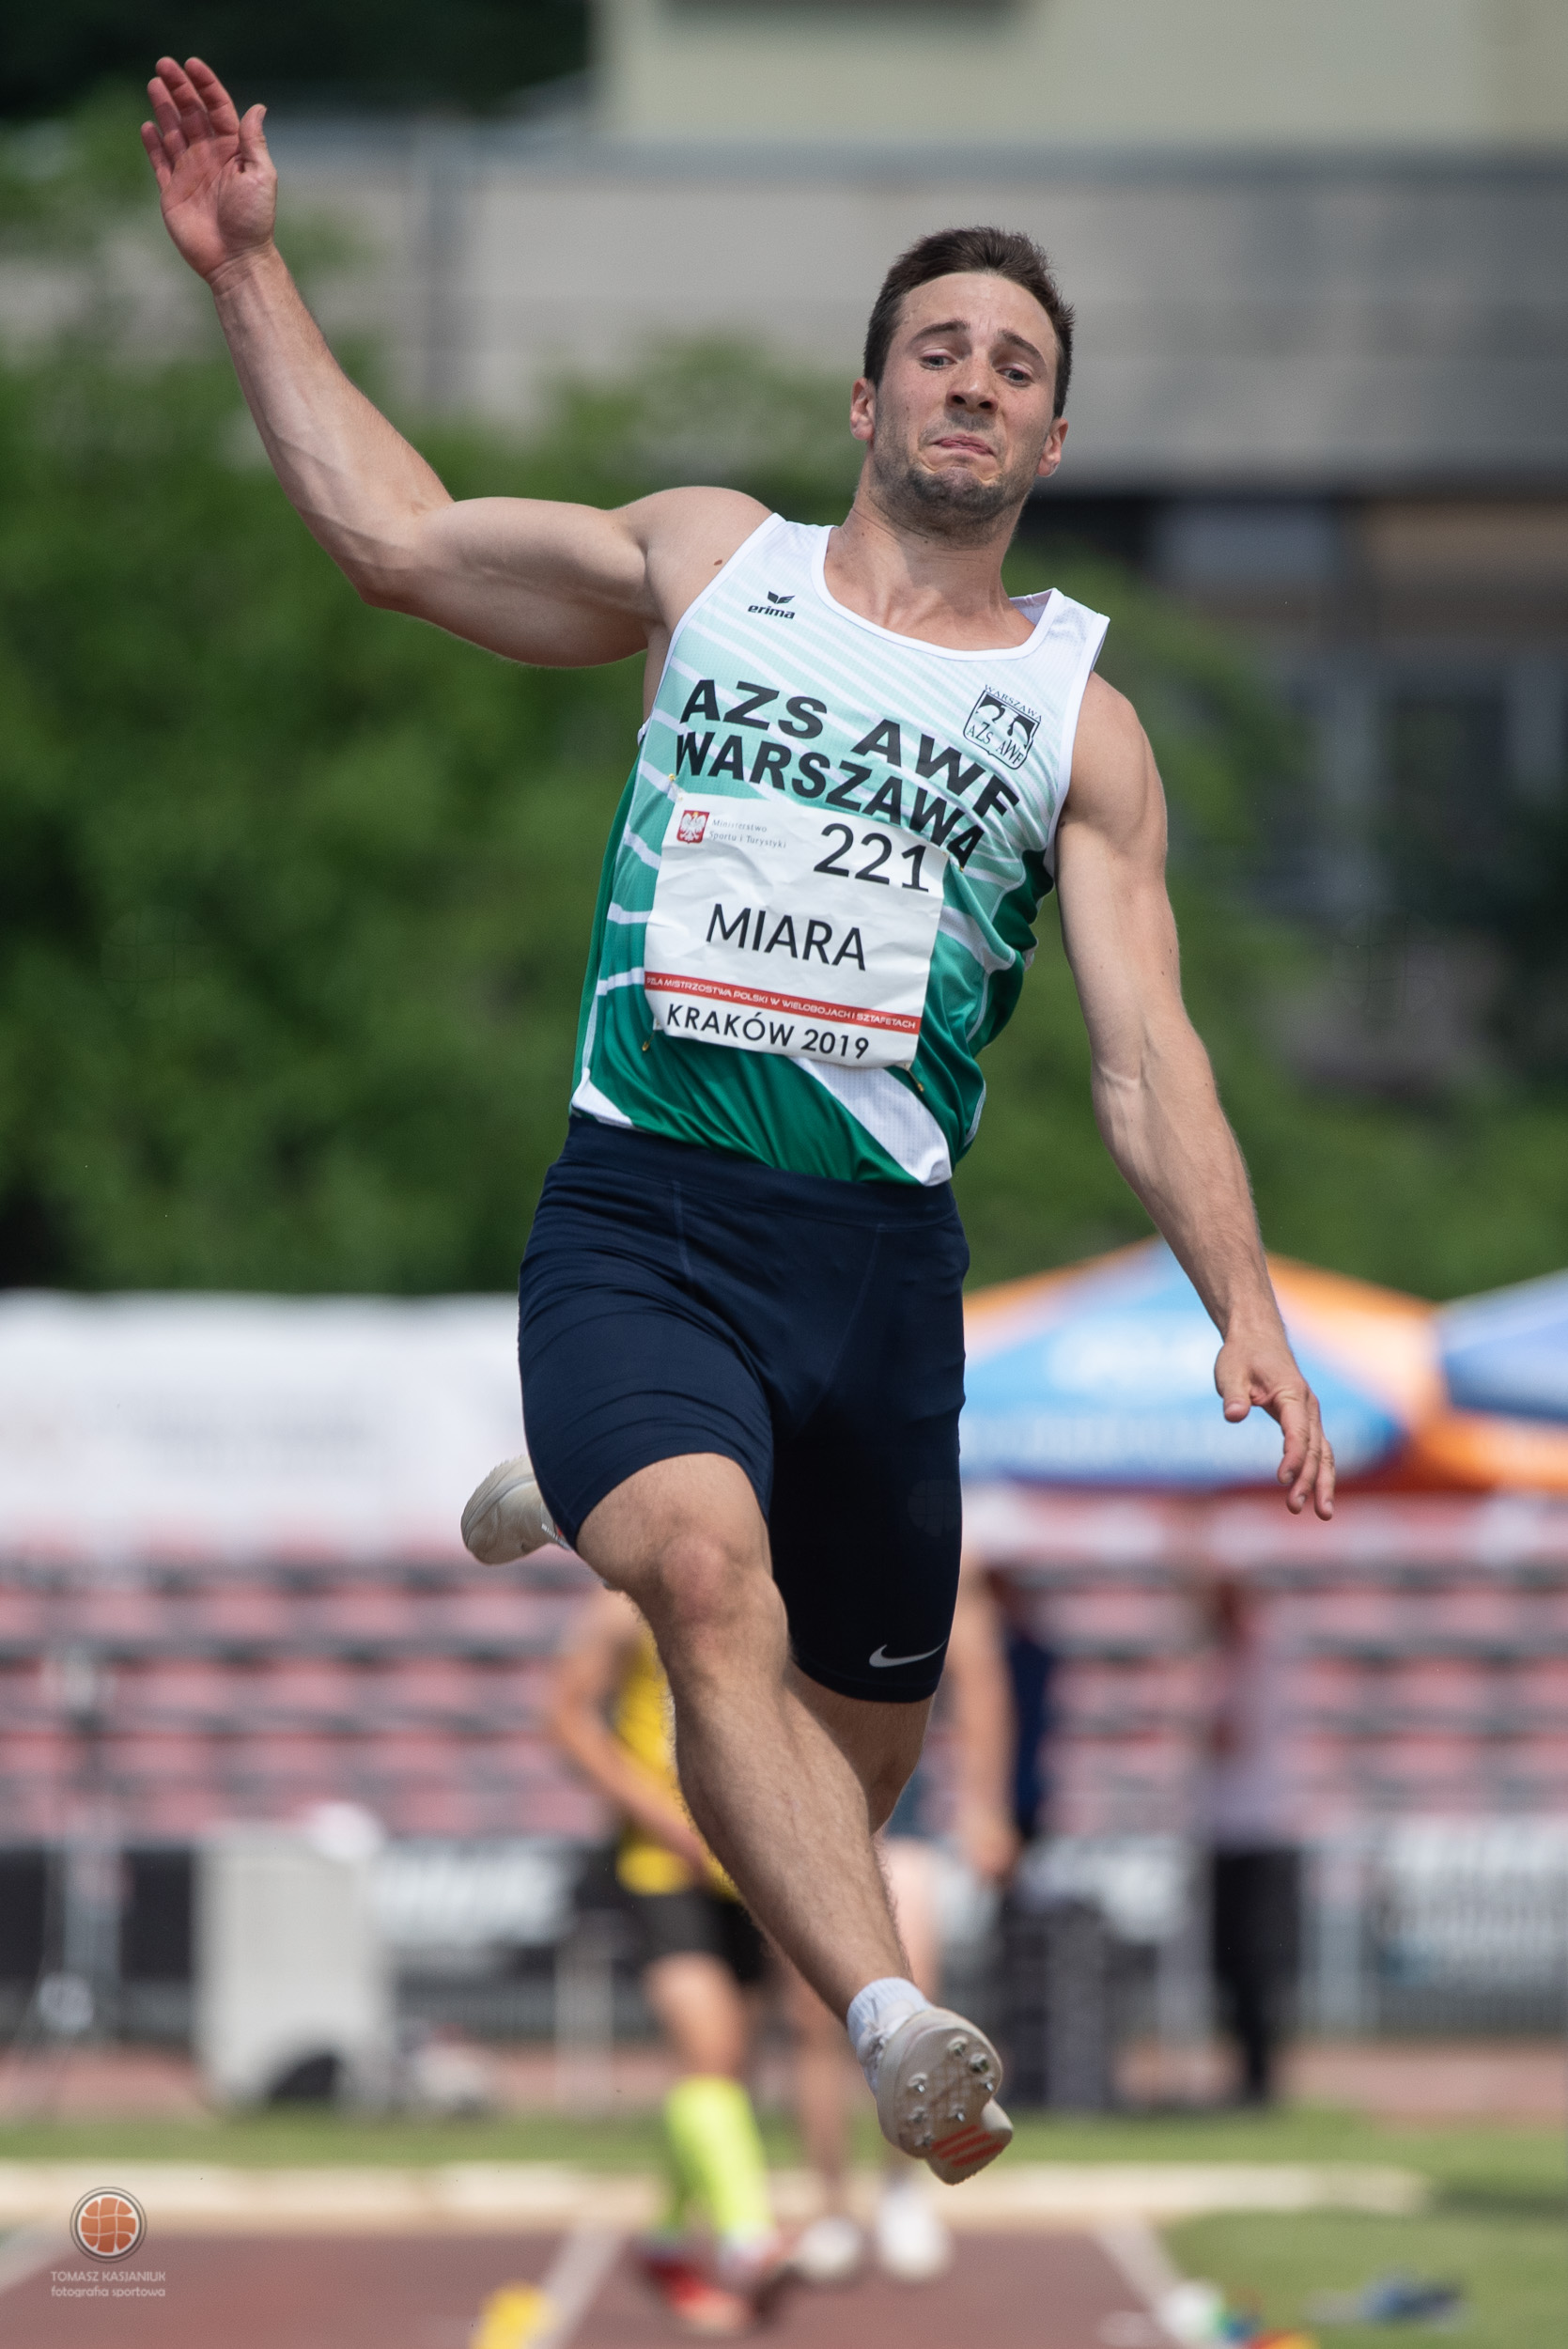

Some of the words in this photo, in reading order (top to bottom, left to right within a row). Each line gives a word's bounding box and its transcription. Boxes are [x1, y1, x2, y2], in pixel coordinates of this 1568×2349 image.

[748, 605, 796, 619] erima
[985, 684, 1042, 723] WARSZAWA
[679, 679, 828, 739] AZS
[850, 719, 1020, 819] AWF
[967, 722, 994, 745] AZS
[996, 739, 1024, 765] AWF
[675, 731, 986, 870] WARSZAWA
[709, 831, 737, 842] Sportu
[746, 834, 787, 849] Turystyki
[712, 819, 768, 832] Ministerstwo
[814, 823, 929, 893] 221
[706, 903, 866, 972] MIARA
[663, 980, 732, 998] MISTRZOSTWA
[733, 990, 768, 1004] POLSKI
[770, 997, 780, 1006] W
[782, 1000, 851, 1019] WIELOBOJACH
[856, 1013, 916, 1029] SZTAFETACH
[666, 1003, 795, 1048] KRAKÓW
[800, 1029, 870, 1060] 2019
